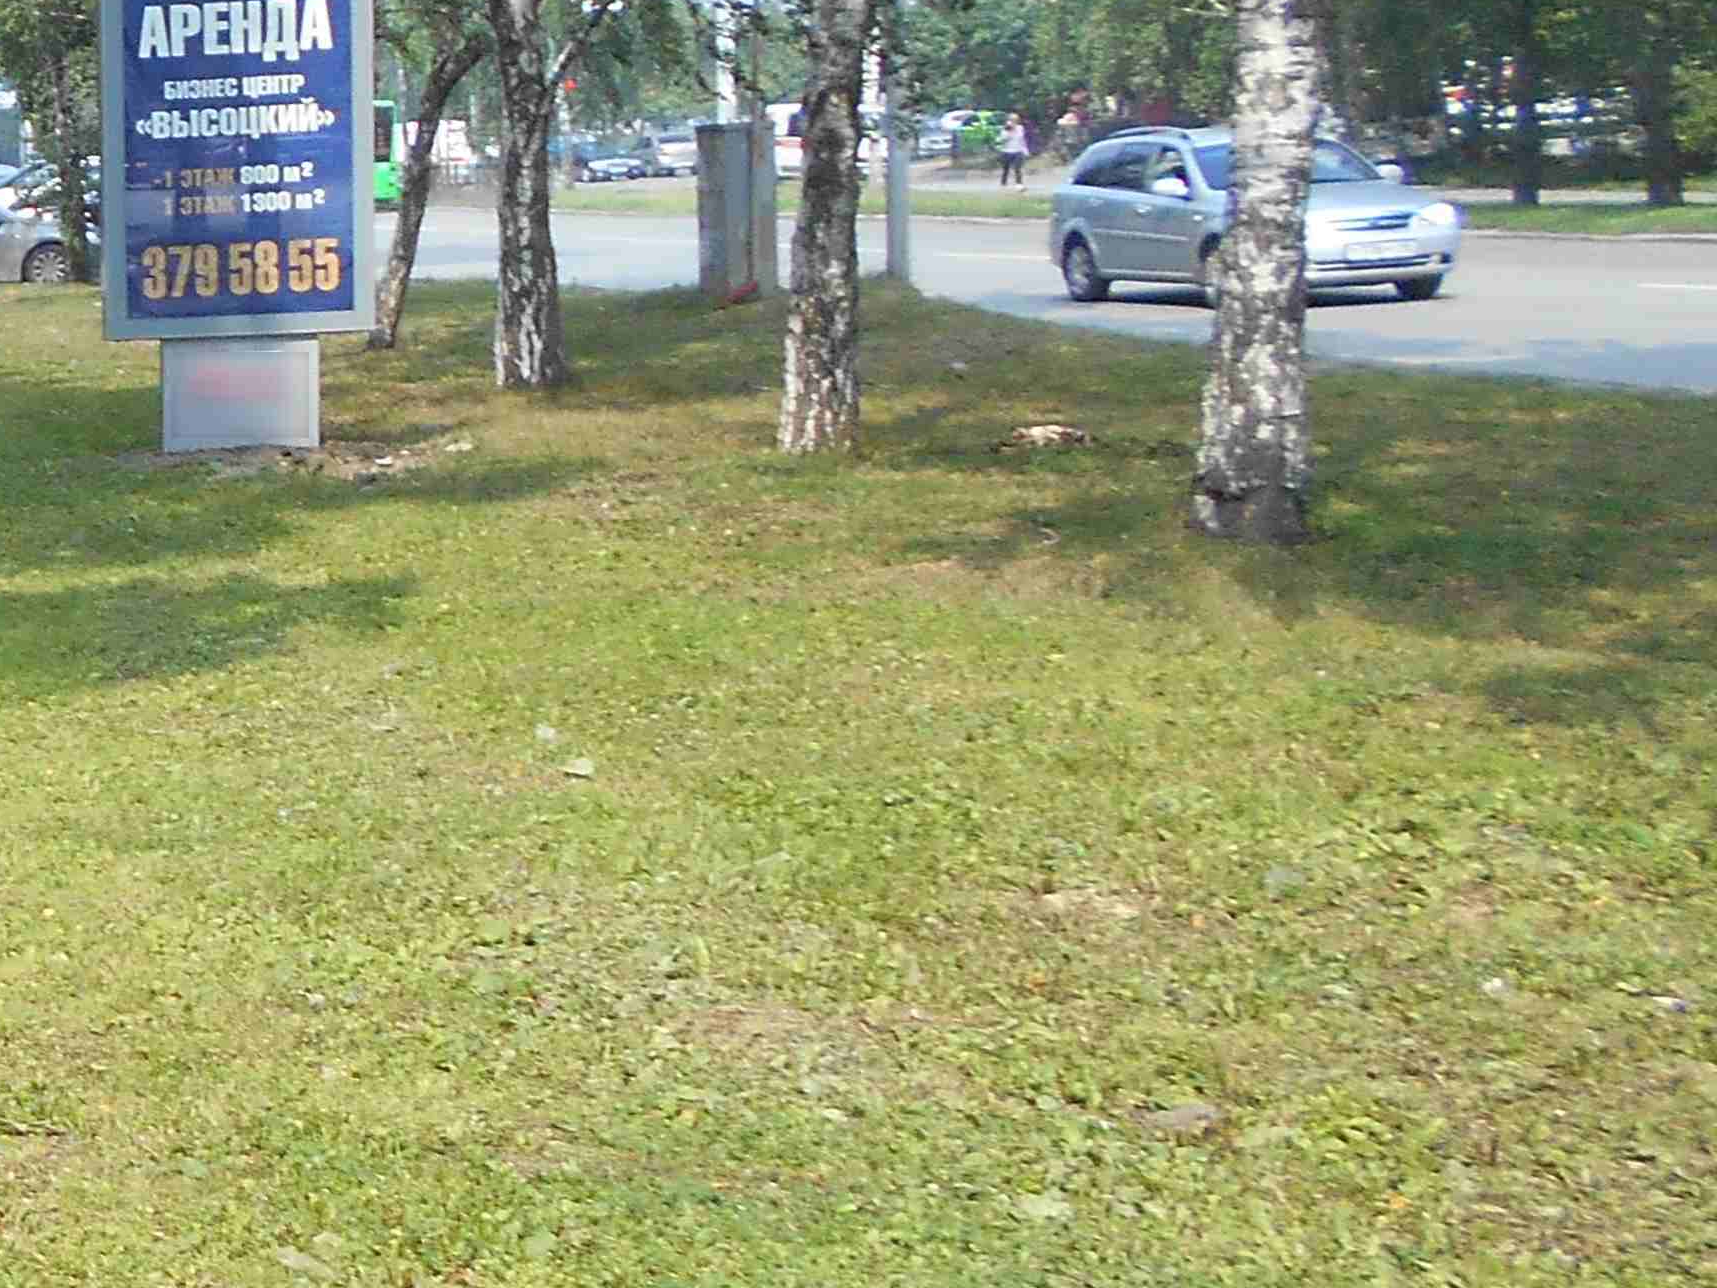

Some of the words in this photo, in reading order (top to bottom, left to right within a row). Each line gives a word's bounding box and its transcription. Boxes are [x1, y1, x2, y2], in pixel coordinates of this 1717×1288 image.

[163, 77, 239, 100] БИЗНЕС
[242, 74, 305, 99] ЦЕНТР
[240, 191, 292, 213] 1300
[141, 243, 219, 300] 379
[229, 240, 280, 296] 58
[288, 238, 341, 292] 55
